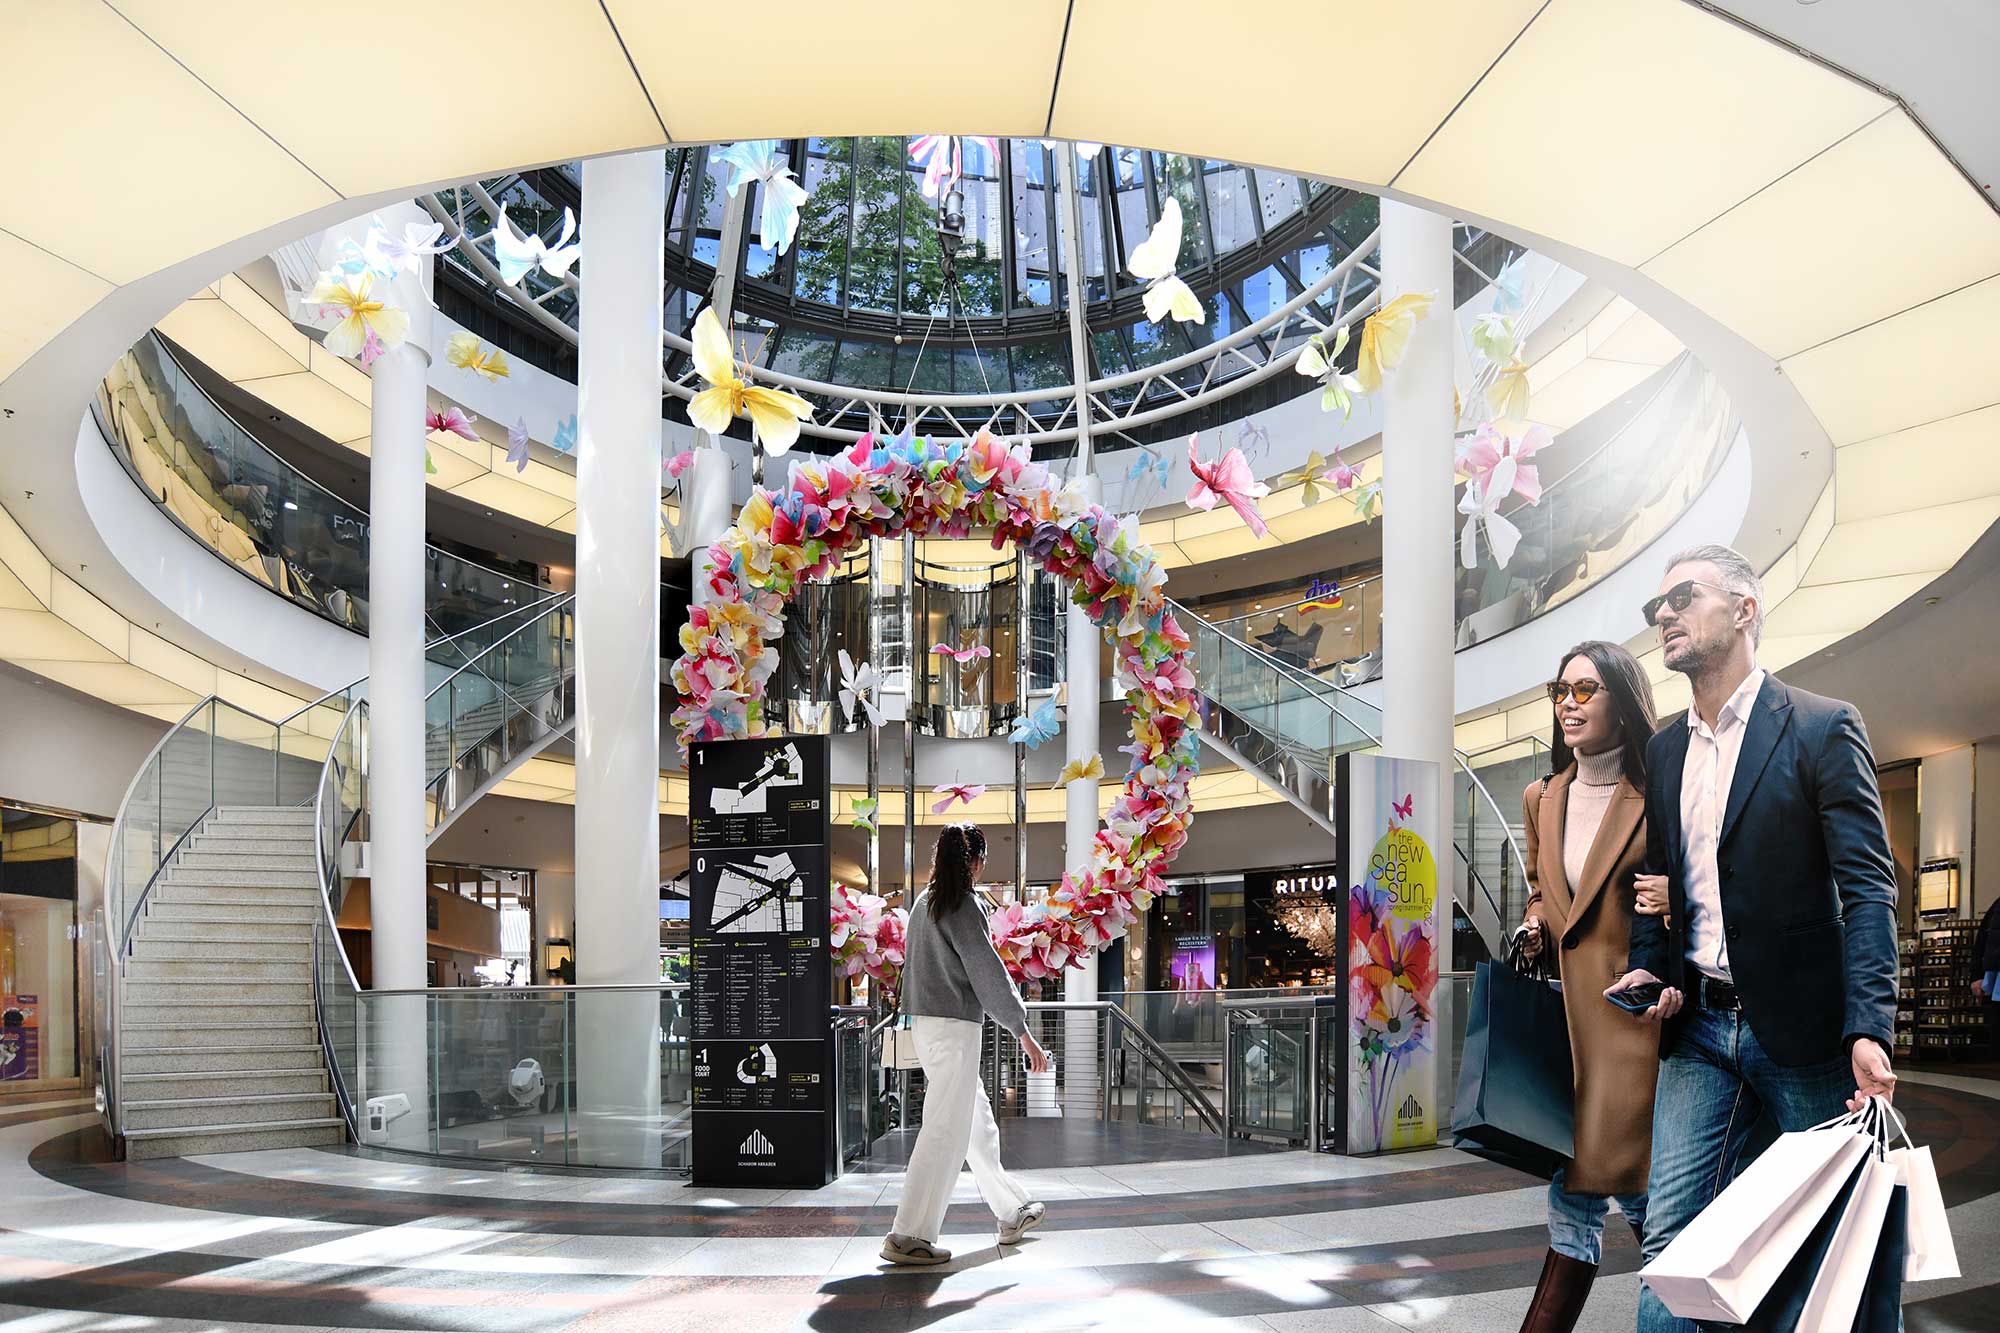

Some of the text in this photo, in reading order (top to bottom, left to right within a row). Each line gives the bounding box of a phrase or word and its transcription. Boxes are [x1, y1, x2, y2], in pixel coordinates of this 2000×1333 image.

[1305, 579, 1339, 600] dm
[697, 750, 704, 765] 1
[1398, 834, 1412, 845] the
[1388, 844, 1424, 863] new
[697, 857, 706, 873] 0
[1388, 882, 1424, 904] sun
[1423, 897, 1432, 926] 2025
[696, 1048, 707, 1063] -1
